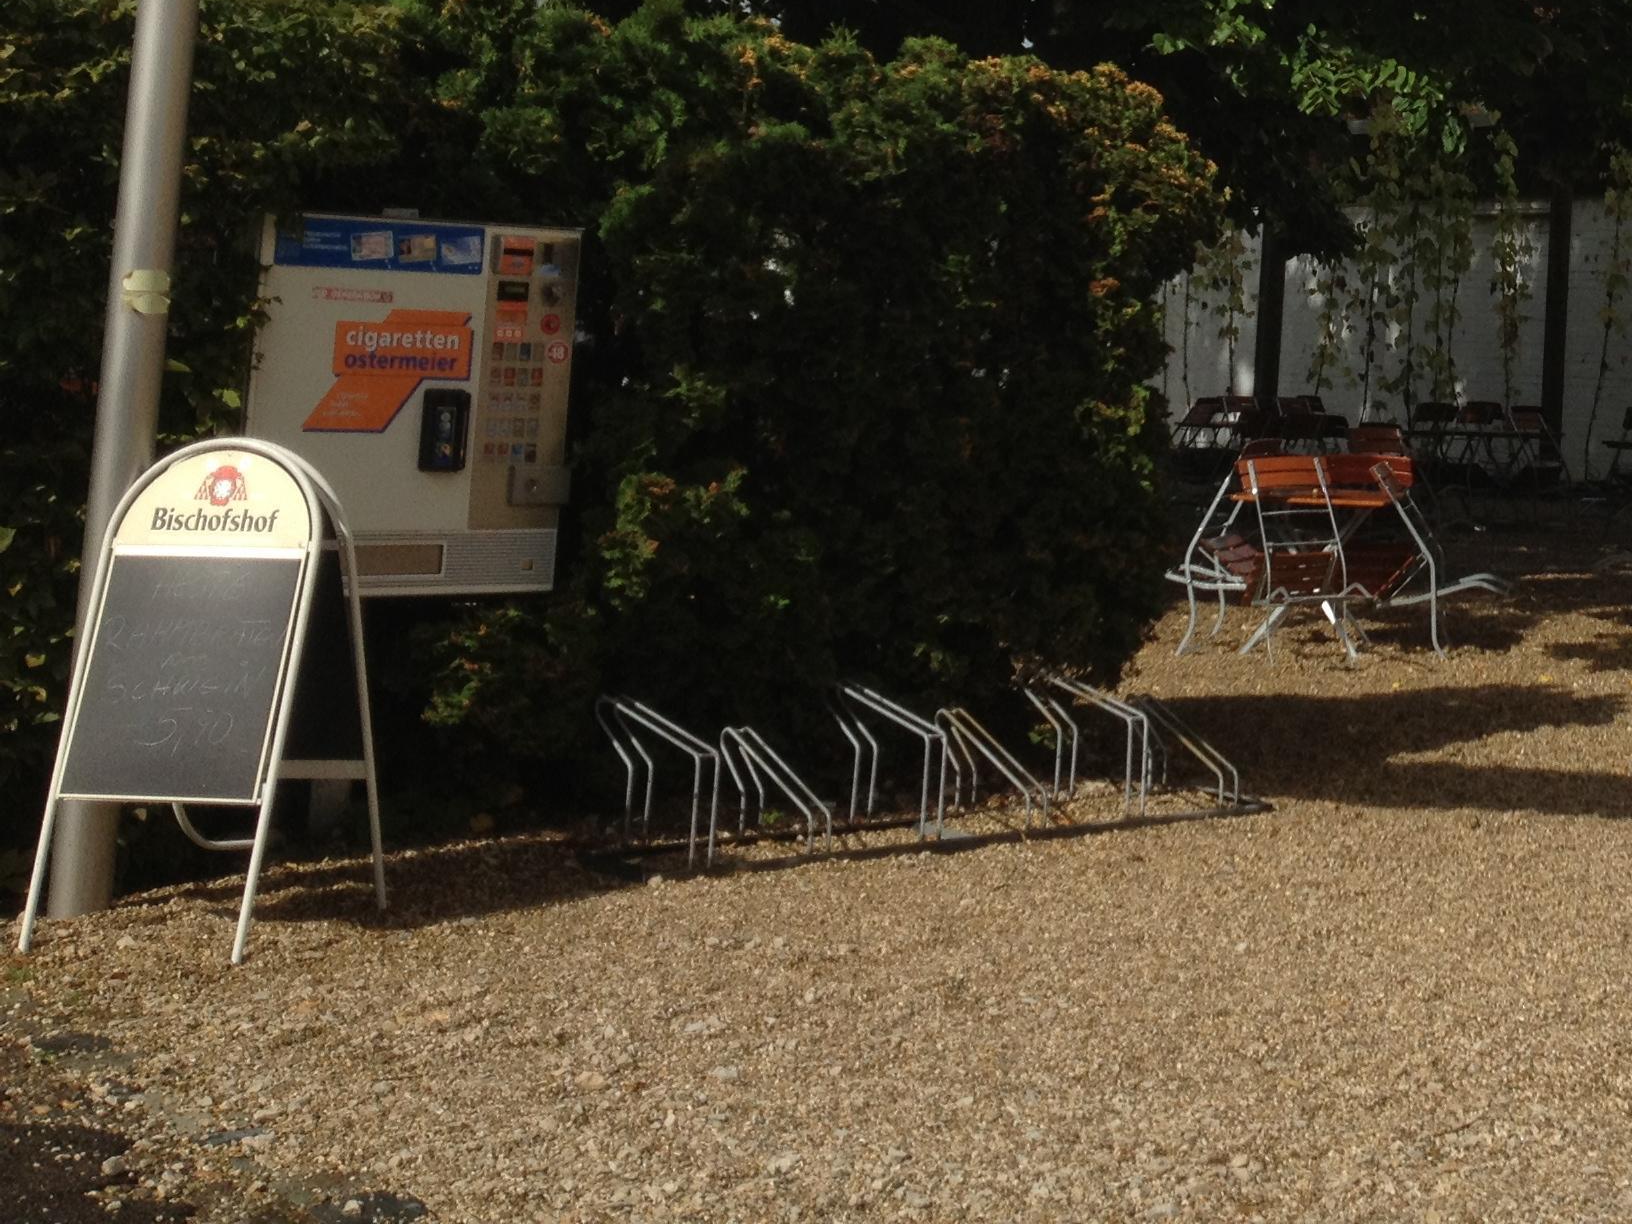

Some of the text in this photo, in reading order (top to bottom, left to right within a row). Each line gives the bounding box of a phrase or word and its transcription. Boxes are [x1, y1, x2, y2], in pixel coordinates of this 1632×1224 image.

[345, 326, 460, 352] cigaretten
[344, 350, 458, 372] ostermeier
[151, 507, 279, 533] Bischofshof
